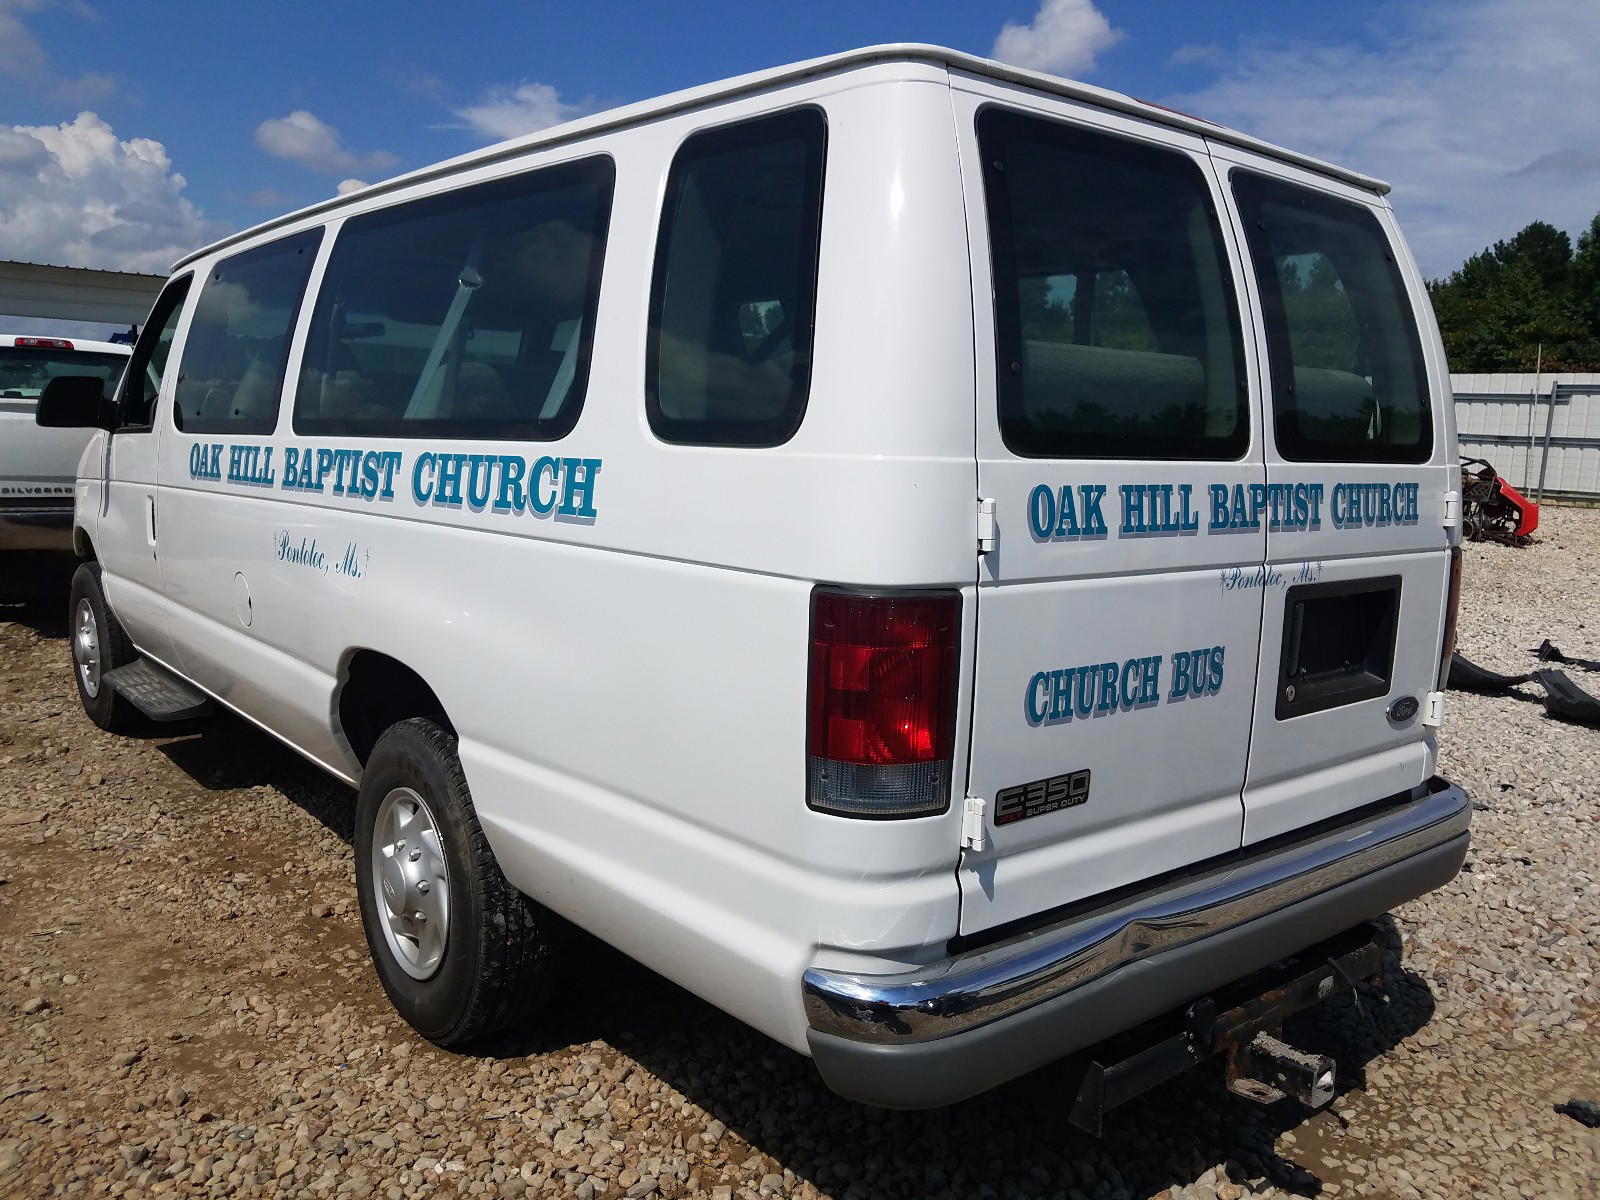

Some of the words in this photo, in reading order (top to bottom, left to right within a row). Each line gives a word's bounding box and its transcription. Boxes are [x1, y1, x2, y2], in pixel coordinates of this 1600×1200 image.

[190, 443, 224, 481] OAK
[227, 445, 275, 488] HILL
[281, 447, 402, 502] BAPTIST
[412, 451, 602, 526] CHURCH
[1027, 484, 1108, 543] OAK
[1118, 484, 1199, 539] HILL
[1208, 483, 1323, 535] BAPTIST
[1330, 482, 1419, 530] CHURCH
[1024, 655, 1162, 728] CHURCH
[1167, 646, 1225, 704] BUS
[1026, 802, 1058, 816] SUPER
[1060, 794, 1086, 807] DUTY
